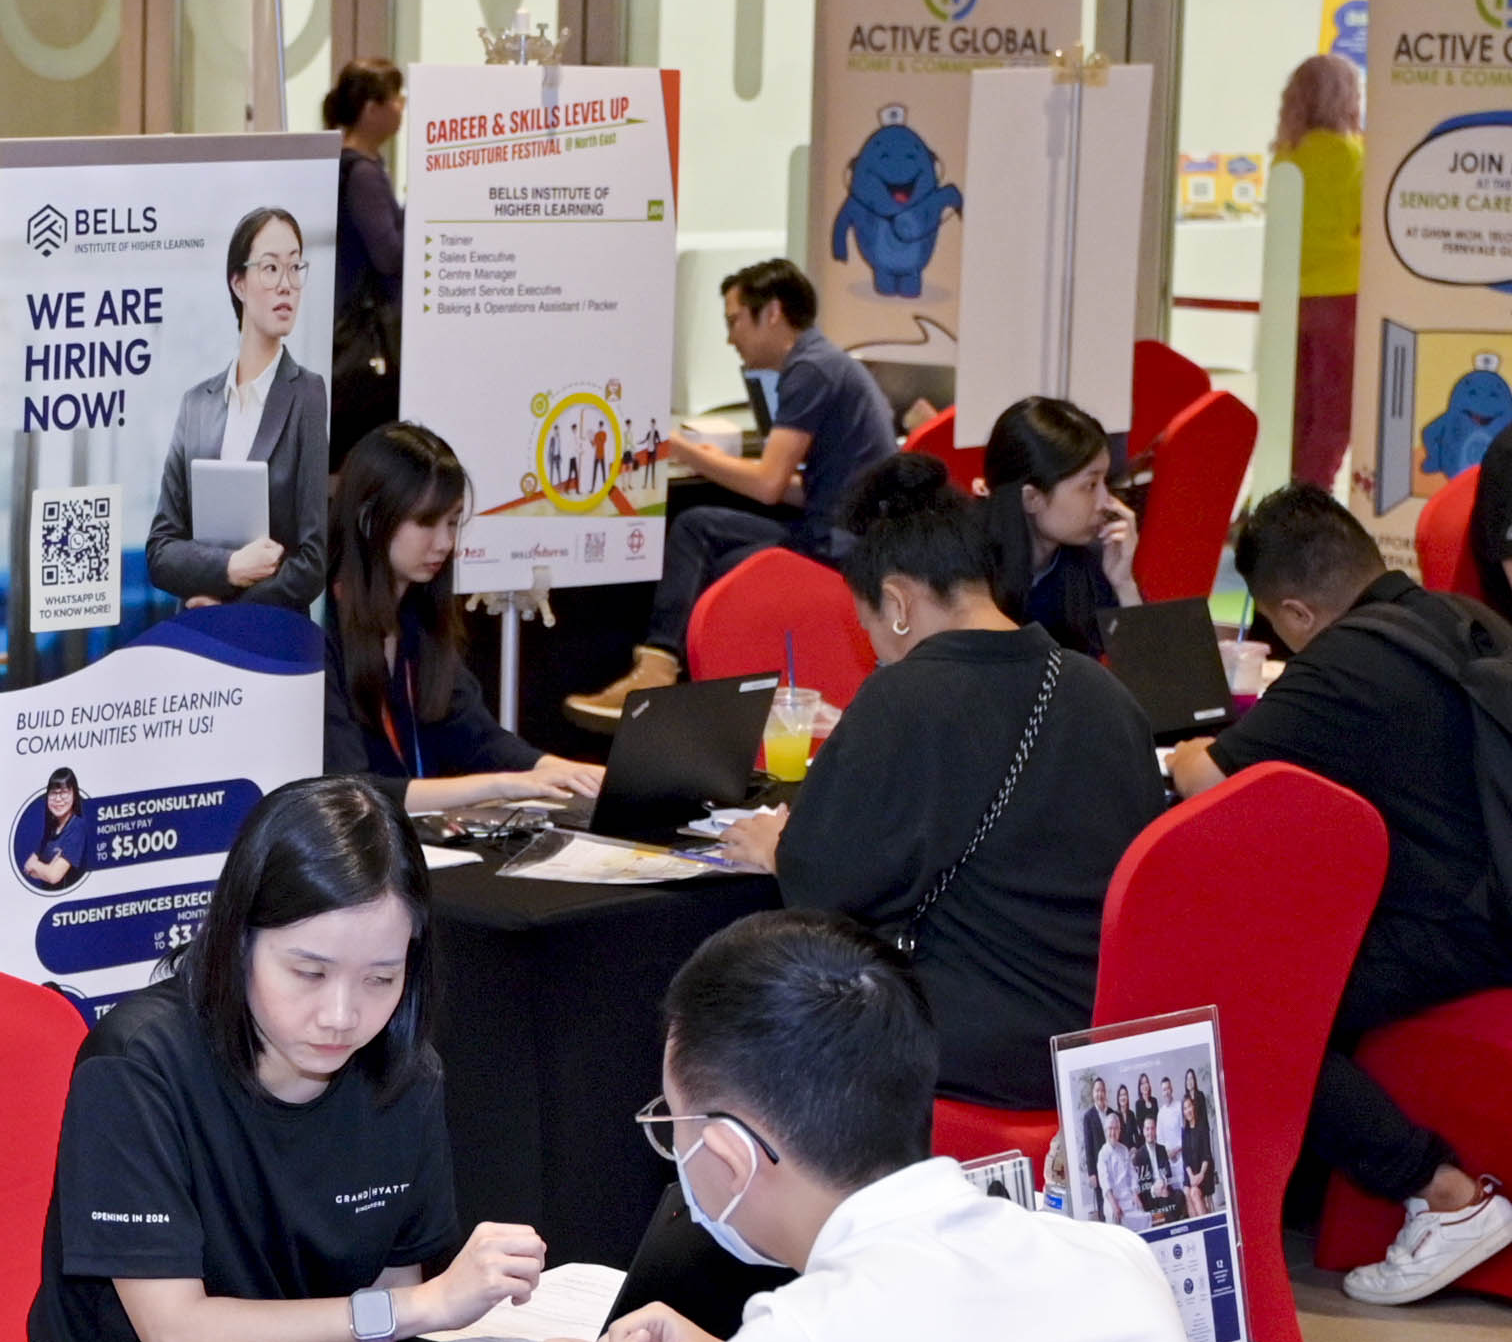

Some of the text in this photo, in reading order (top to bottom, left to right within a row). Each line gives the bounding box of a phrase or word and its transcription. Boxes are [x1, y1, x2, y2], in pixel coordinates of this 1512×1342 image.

[849, 24, 1055, 59] ACTIVE GLOBAL
[1393, 33, 1493, 63] ACTIVE
[1391, 68, 1440, 84] HOME
[1445, 70, 1455, 86] &
[426, 96, 629, 144] CAREER & SKILLS LEVEL UP
[426, 136, 561, 171] SKILLSFUTURE FESTIVAL
[1449, 152, 1503, 174] JOIN
[488, 186, 609, 200] BELLS INSTITUTE OF
[1399, 191, 1460, 211] SENIOR
[1465, 194, 1512, 213] CARE
[494, 202, 603, 216] HIGHER LEARNING
[75, 206, 157, 235] BELLS
[74, 238, 204, 253] INSTITUTE OF HIGHER LEARNING
[439, 233, 473, 246] Trainer
[439, 251, 515, 263] Sales Executive
[437, 268, 516, 282] Centre Manager
[438, 283, 562, 297] Student Service Executive
[26, 287, 163, 330] WE ARE
[25, 338, 151, 382] HIRING
[23, 389, 125, 435] NOW!
[44, 591, 106, 605] WHATSAPP US
[39, 603, 111, 618] TO KNOW MORE!
[16, 687, 242, 730] BUILD ENJOYABLE LEARNING
[16, 715, 213, 755] COMMUNITIES WITH US!
[97, 790, 225, 821] SALES CONSULTANT
[96, 818, 152, 835] MONTHLY PAY
[111, 828, 177, 860] $5,000
[52, 906, 113, 927] STUDENT
[114, 896, 173, 919] SERVICES
[91, 1211, 169, 1223] OPENING IN 2024
